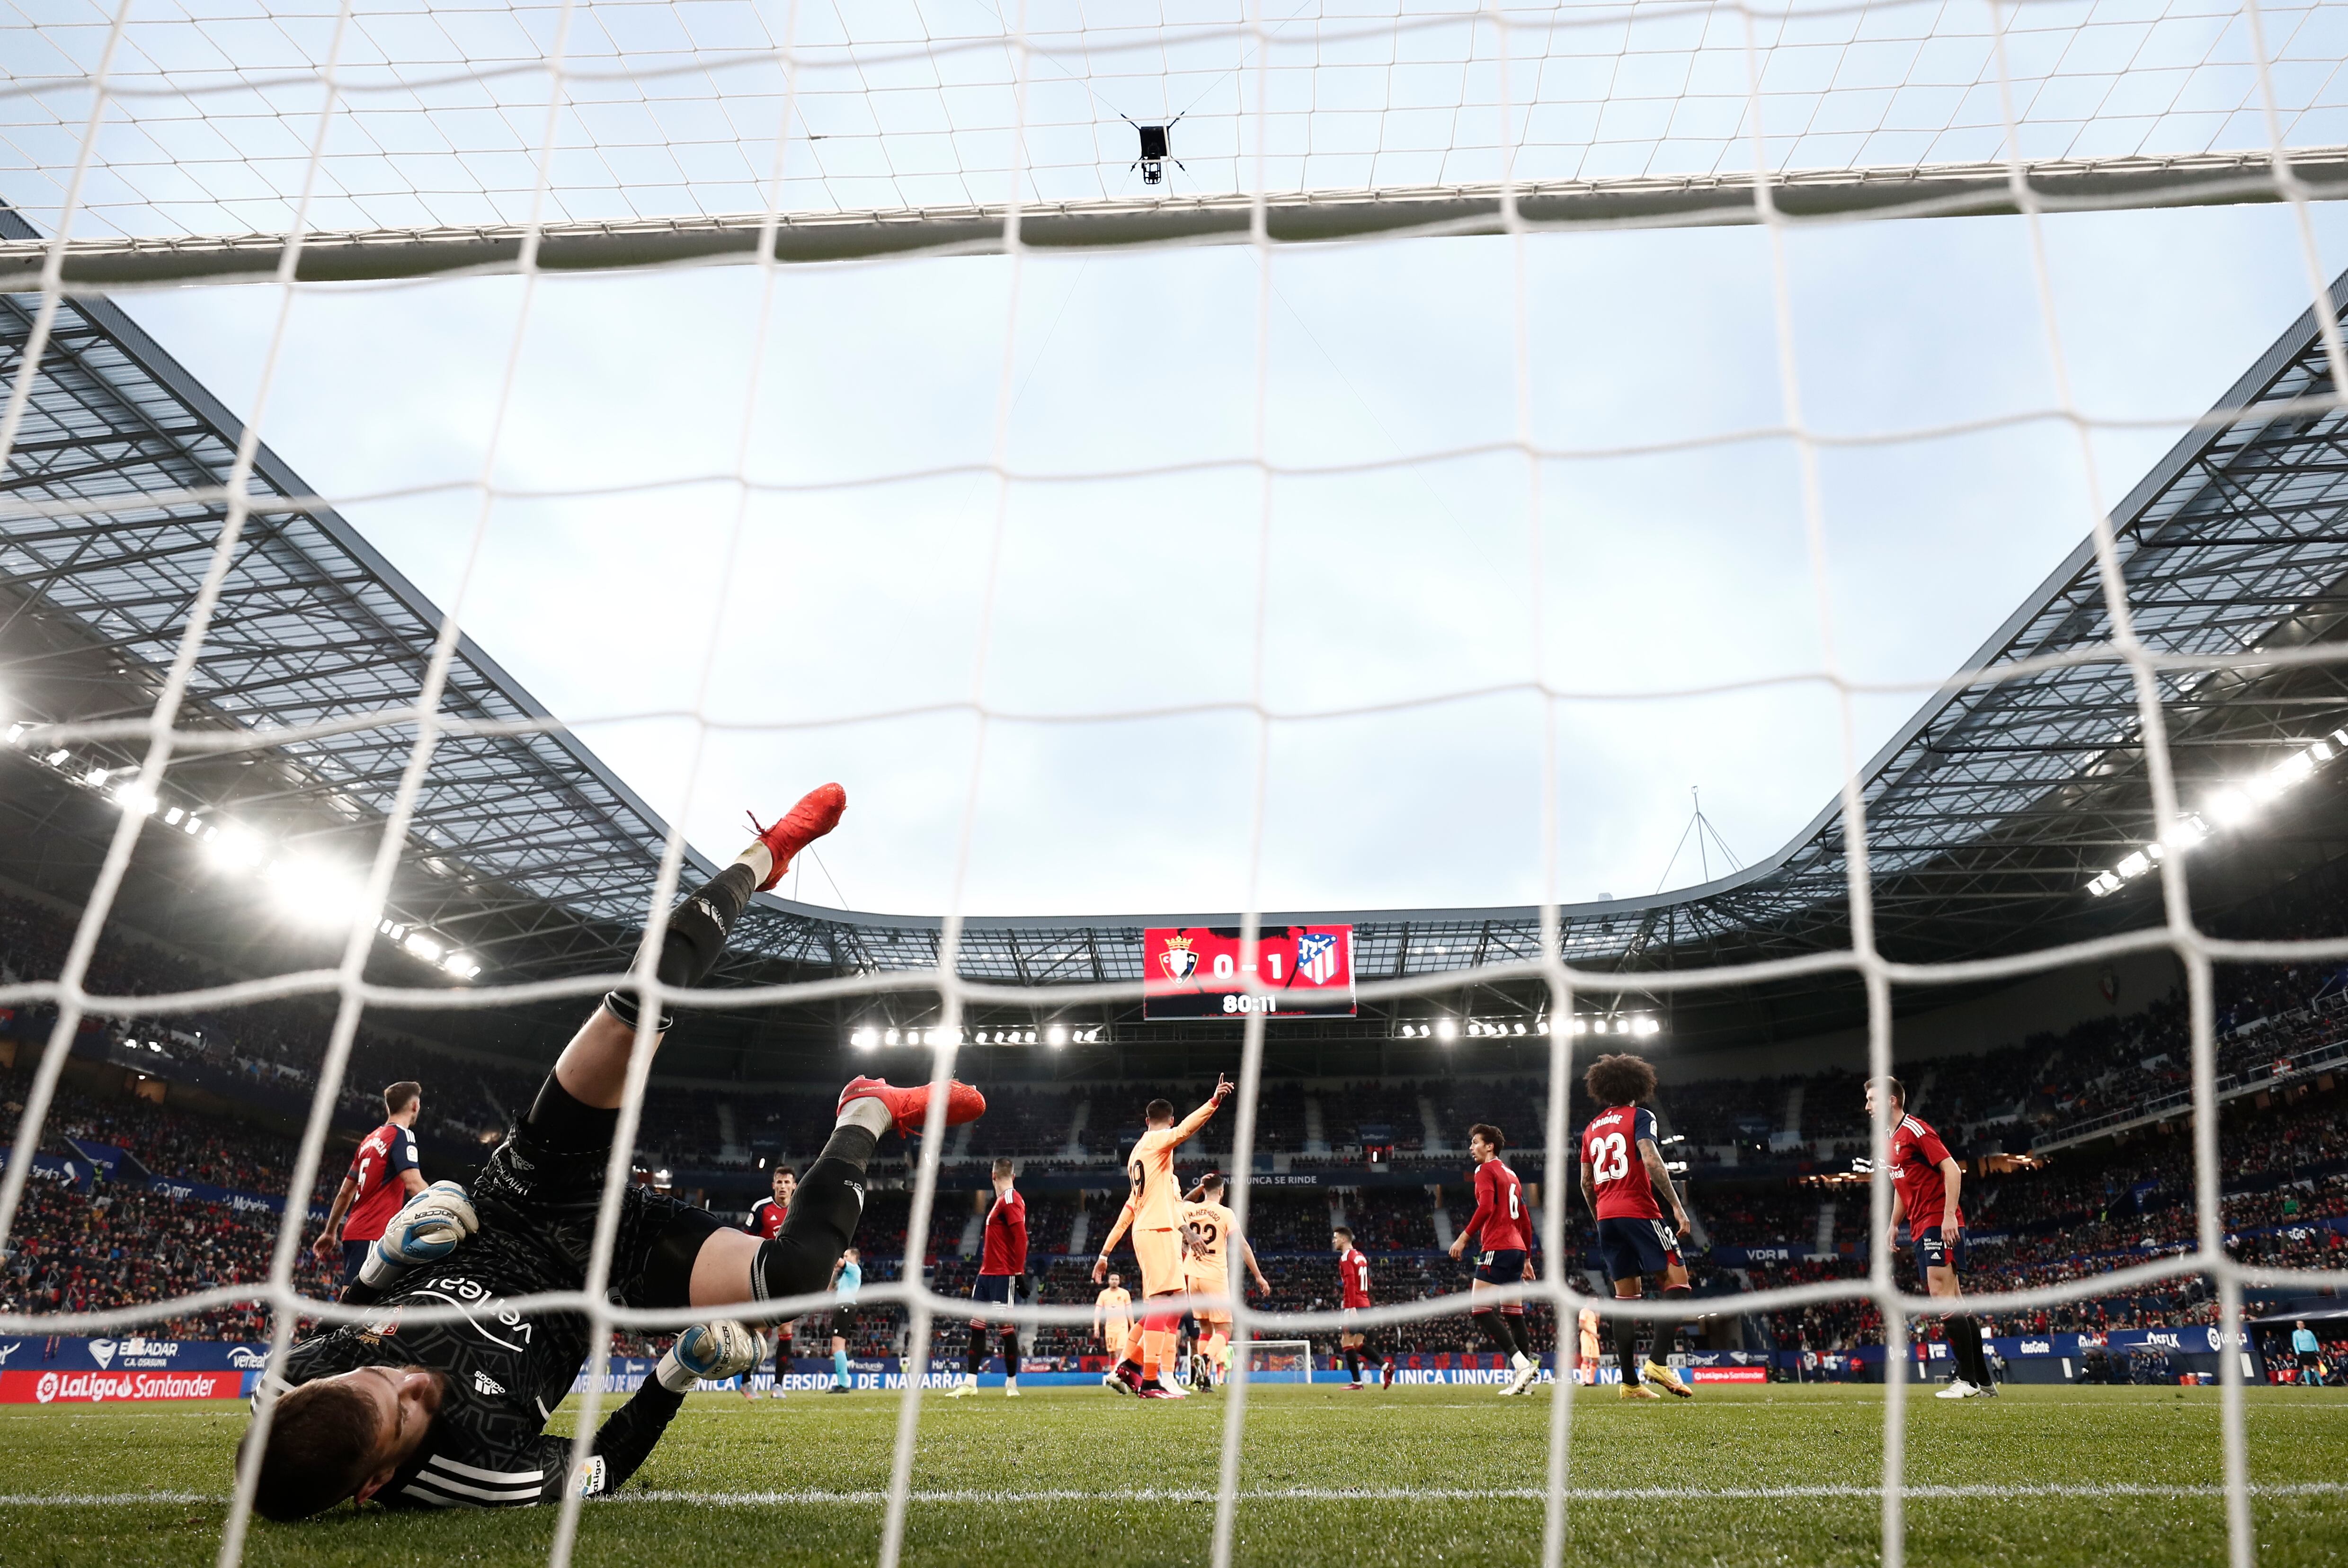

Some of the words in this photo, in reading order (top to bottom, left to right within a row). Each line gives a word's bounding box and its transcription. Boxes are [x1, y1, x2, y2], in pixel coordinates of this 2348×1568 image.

[1213, 953, 1234, 980] 0
[1267, 953, 1282, 980] 1
[1222, 994, 1277, 1013] 80:11
[1591, 1114, 1623, 1132] ARIDANE
[1590, 1131, 1628, 1185] 23
[354, 1158, 371, 1203] 5
[1274, 1176, 1286, 1184] SE
[1288, 1176, 1317, 1184] RINDE
[1508, 1183, 1520, 1220] 6
[1196, 1208, 1220, 1222] HERMOSO
[1746, 1249, 1776, 1260] VDR
[1358, 1265, 1368, 1292] 11
[2020, 1340, 2050, 1354] dasGate
[59, 1374, 118, 1401] LaLiga
[133, 1372, 217, 1398] Santander
[474, 1370, 506, 1393] adidas
[858, 1373, 879, 1390] DE
[1729, 1372, 1764, 1380] Santander
[593, 1460, 602, 1492] aLiga
